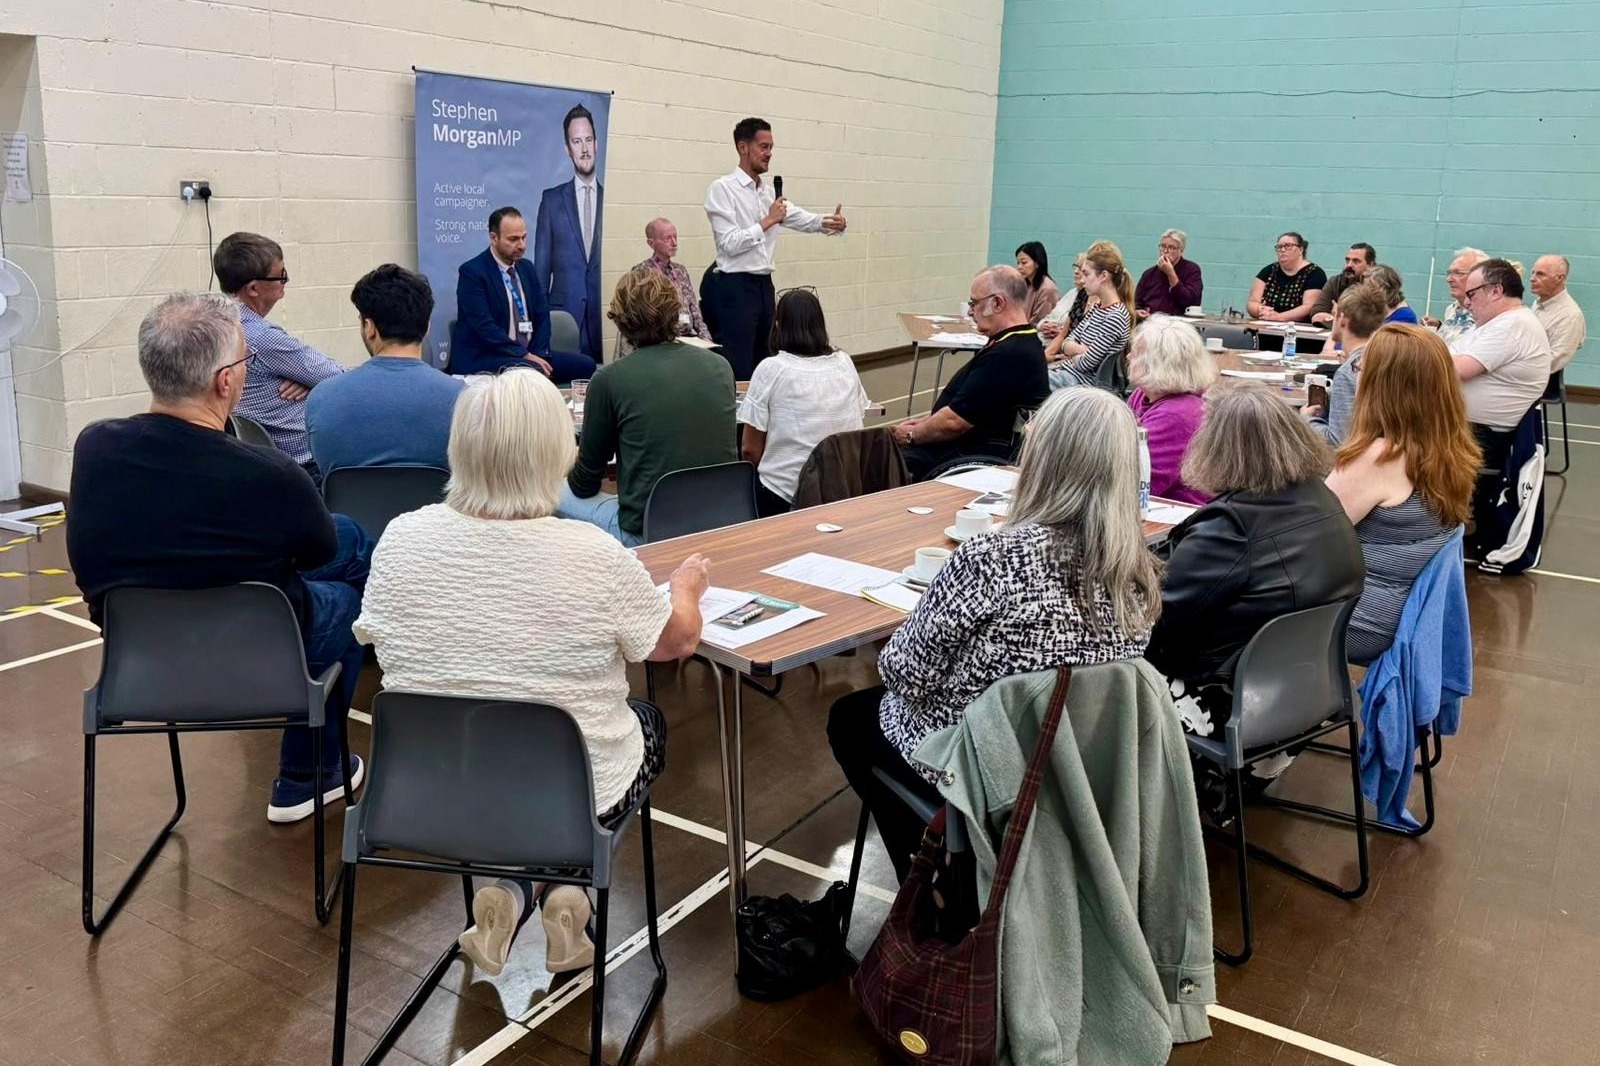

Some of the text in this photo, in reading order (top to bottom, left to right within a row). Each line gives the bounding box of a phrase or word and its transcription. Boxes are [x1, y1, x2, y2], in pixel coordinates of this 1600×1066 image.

[432, 99, 497, 124] Stephen
[433, 123, 521, 148] MorganMP
[434, 183, 485, 194] Active local
[434, 197, 490, 210] campaigner.
[435, 219, 466, 233] Strong
[435, 234, 462, 243] voice.
